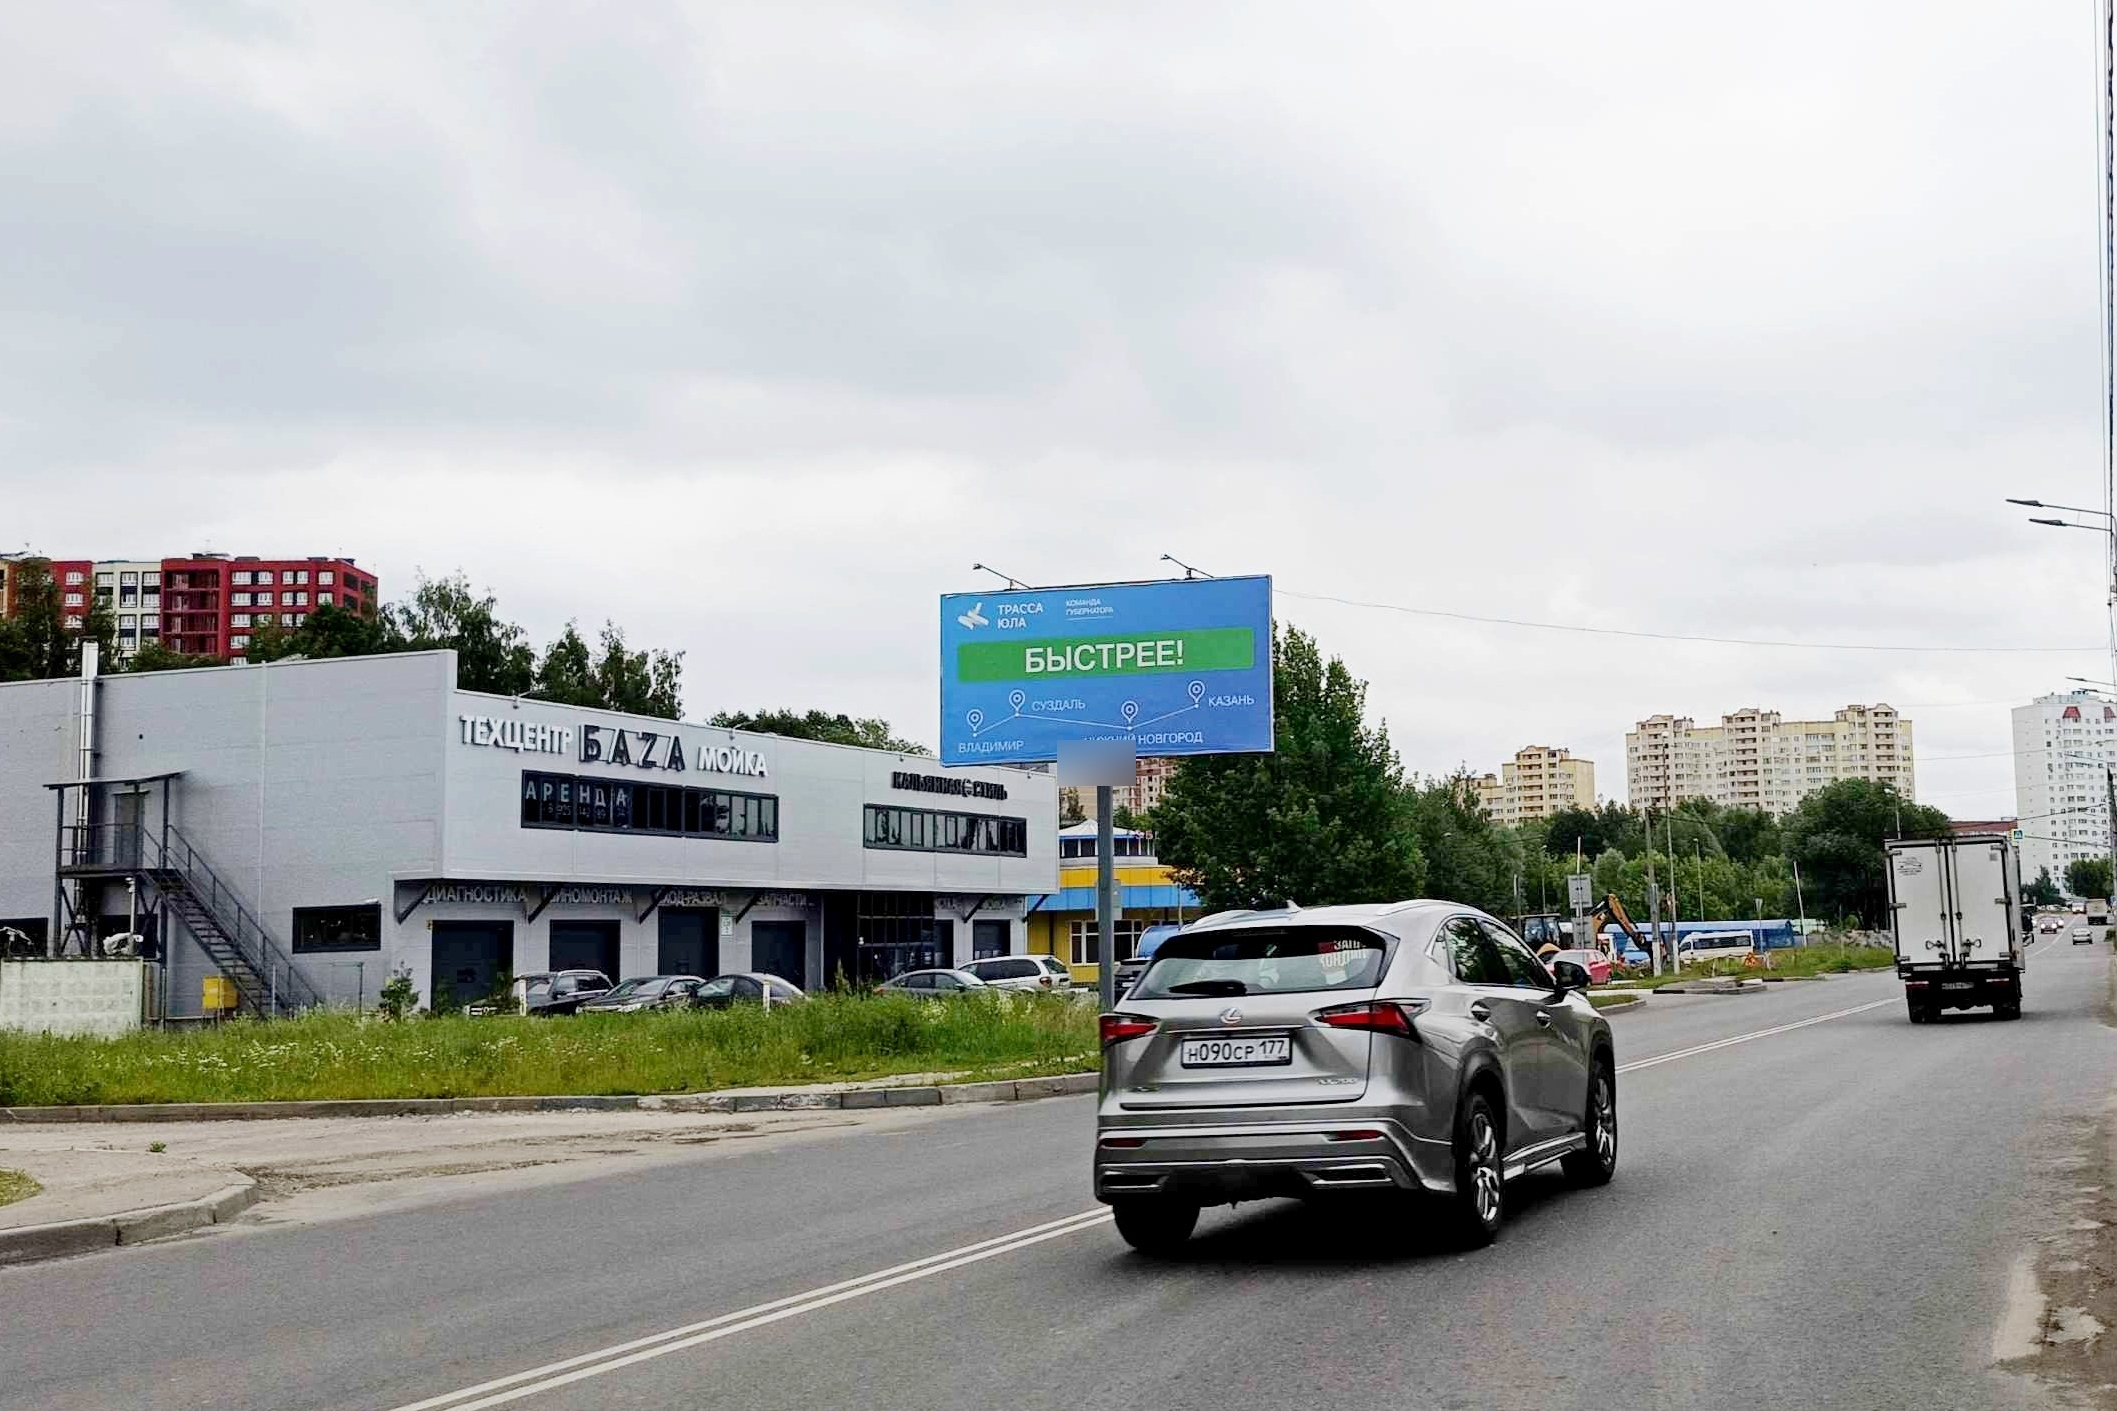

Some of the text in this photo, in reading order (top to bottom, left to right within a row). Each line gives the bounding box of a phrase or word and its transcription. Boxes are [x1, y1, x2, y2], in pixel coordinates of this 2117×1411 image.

[997, 602, 1044, 615] ТРАССА
[997, 617, 1027, 630] ЮЛА
[1025, 640, 1184, 673] БЫСТРЕЕ!
[1032, 698, 1086, 711] СУЗДАЛЬ
[1207, 695, 1255, 707] КАЗАНЬ
[459, 715, 574, 754] ТЕХЦЕНТР
[1138, 731, 1204, 745] НОВГОРОД
[958, 740, 1024, 754] ВЛАДИМИР
[698, 743, 769, 777] МОЙКА
[525, 780, 628, 807] АРЕНДА
[423, 886, 528, 904] ДИАГНОСТИКА
[1259, 1040, 1285, 1054] 177
